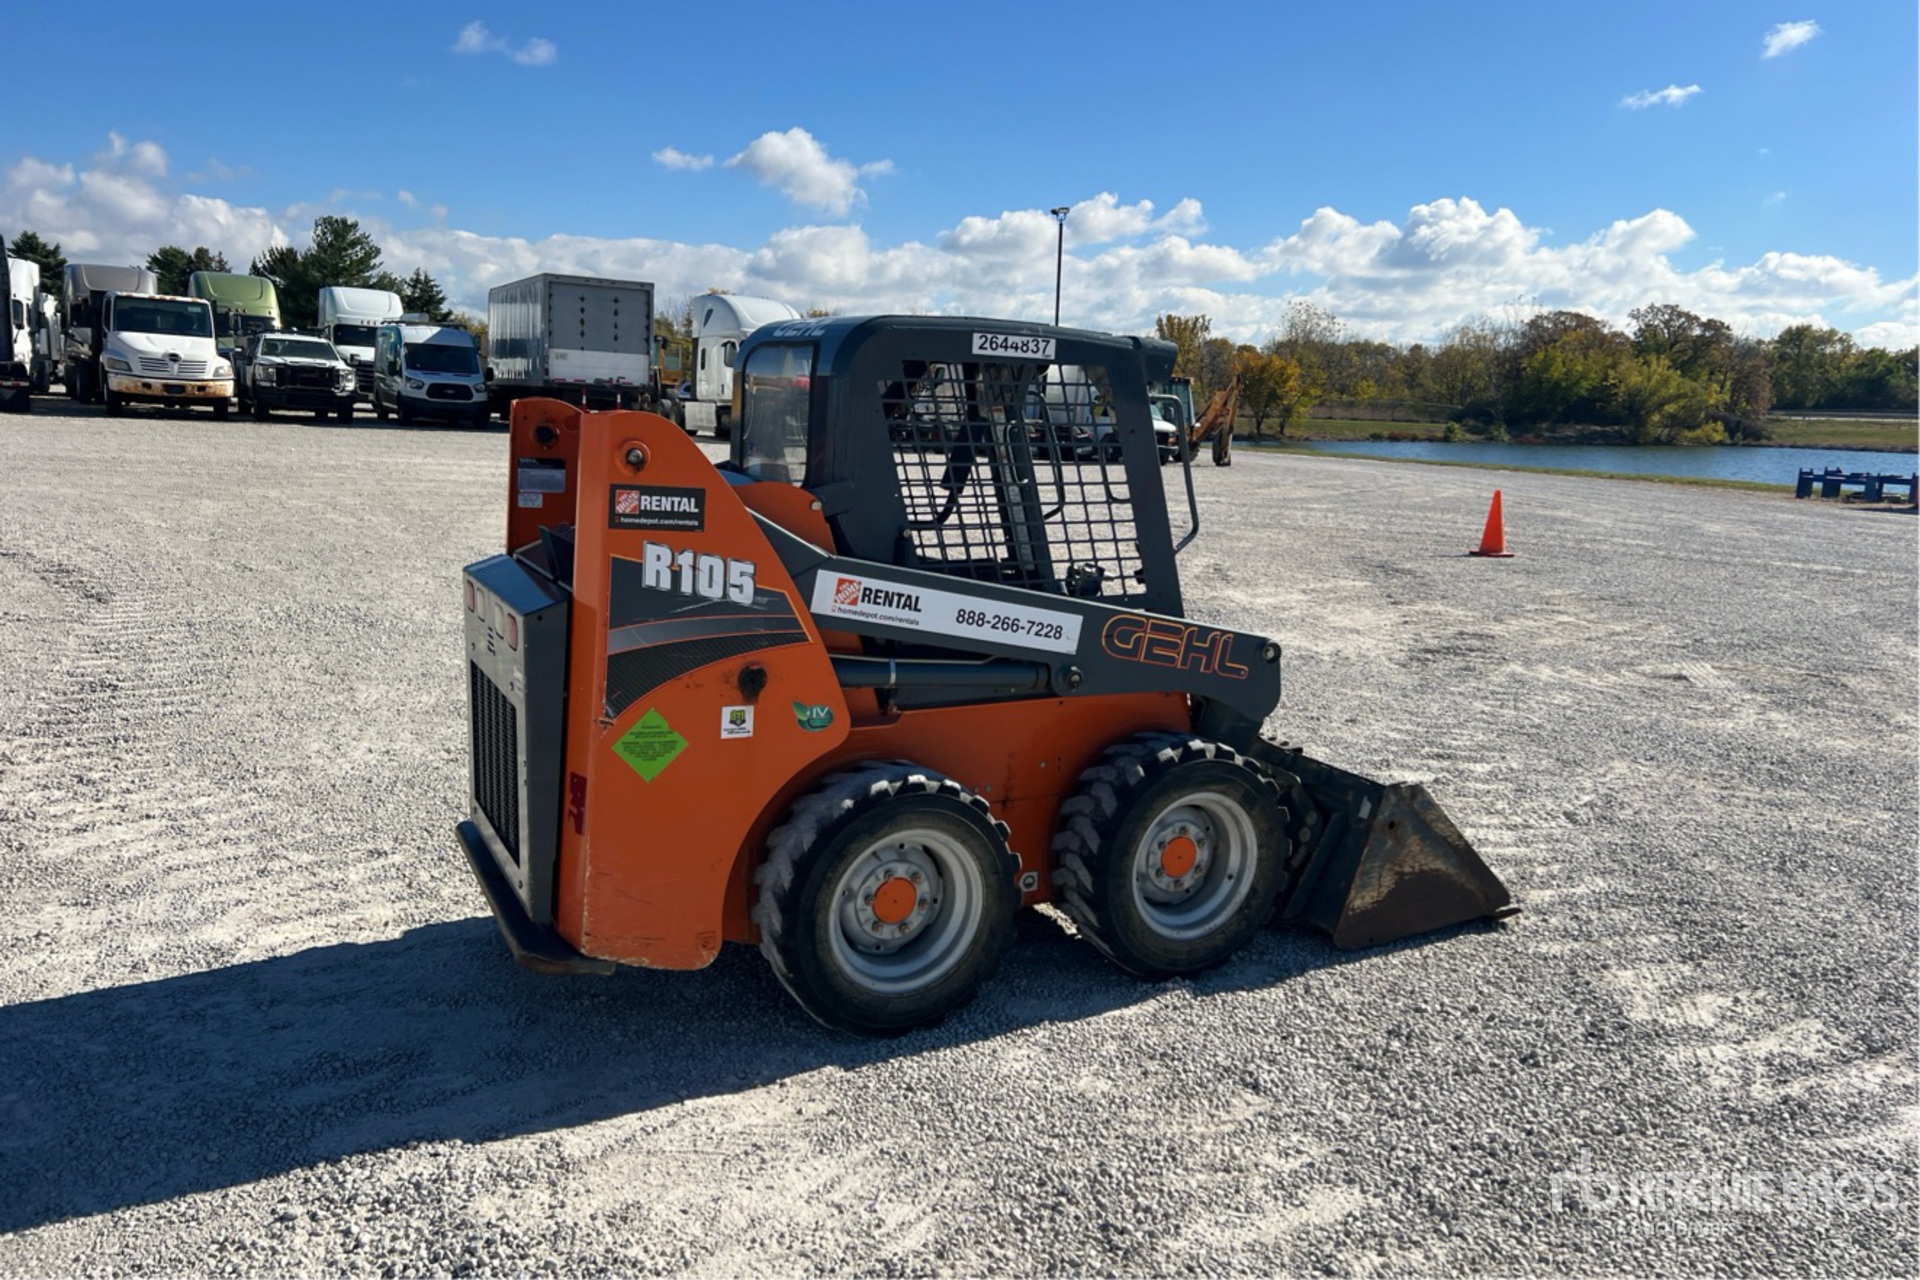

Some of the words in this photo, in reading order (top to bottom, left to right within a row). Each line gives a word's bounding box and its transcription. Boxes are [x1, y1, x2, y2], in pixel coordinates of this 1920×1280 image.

[978, 334, 1051, 355] 2644837
[640, 495, 699, 513] RENTAL
[620, 516, 699, 527] homedepot.com/rentals
[641, 540, 756, 605] R105
[860, 587, 922, 613] RENTAL
[837, 606, 920, 626] homedepot.com/rentals
[955, 608, 1063, 640] 888-266-7228
[1102, 614, 1249, 680] GEHL
